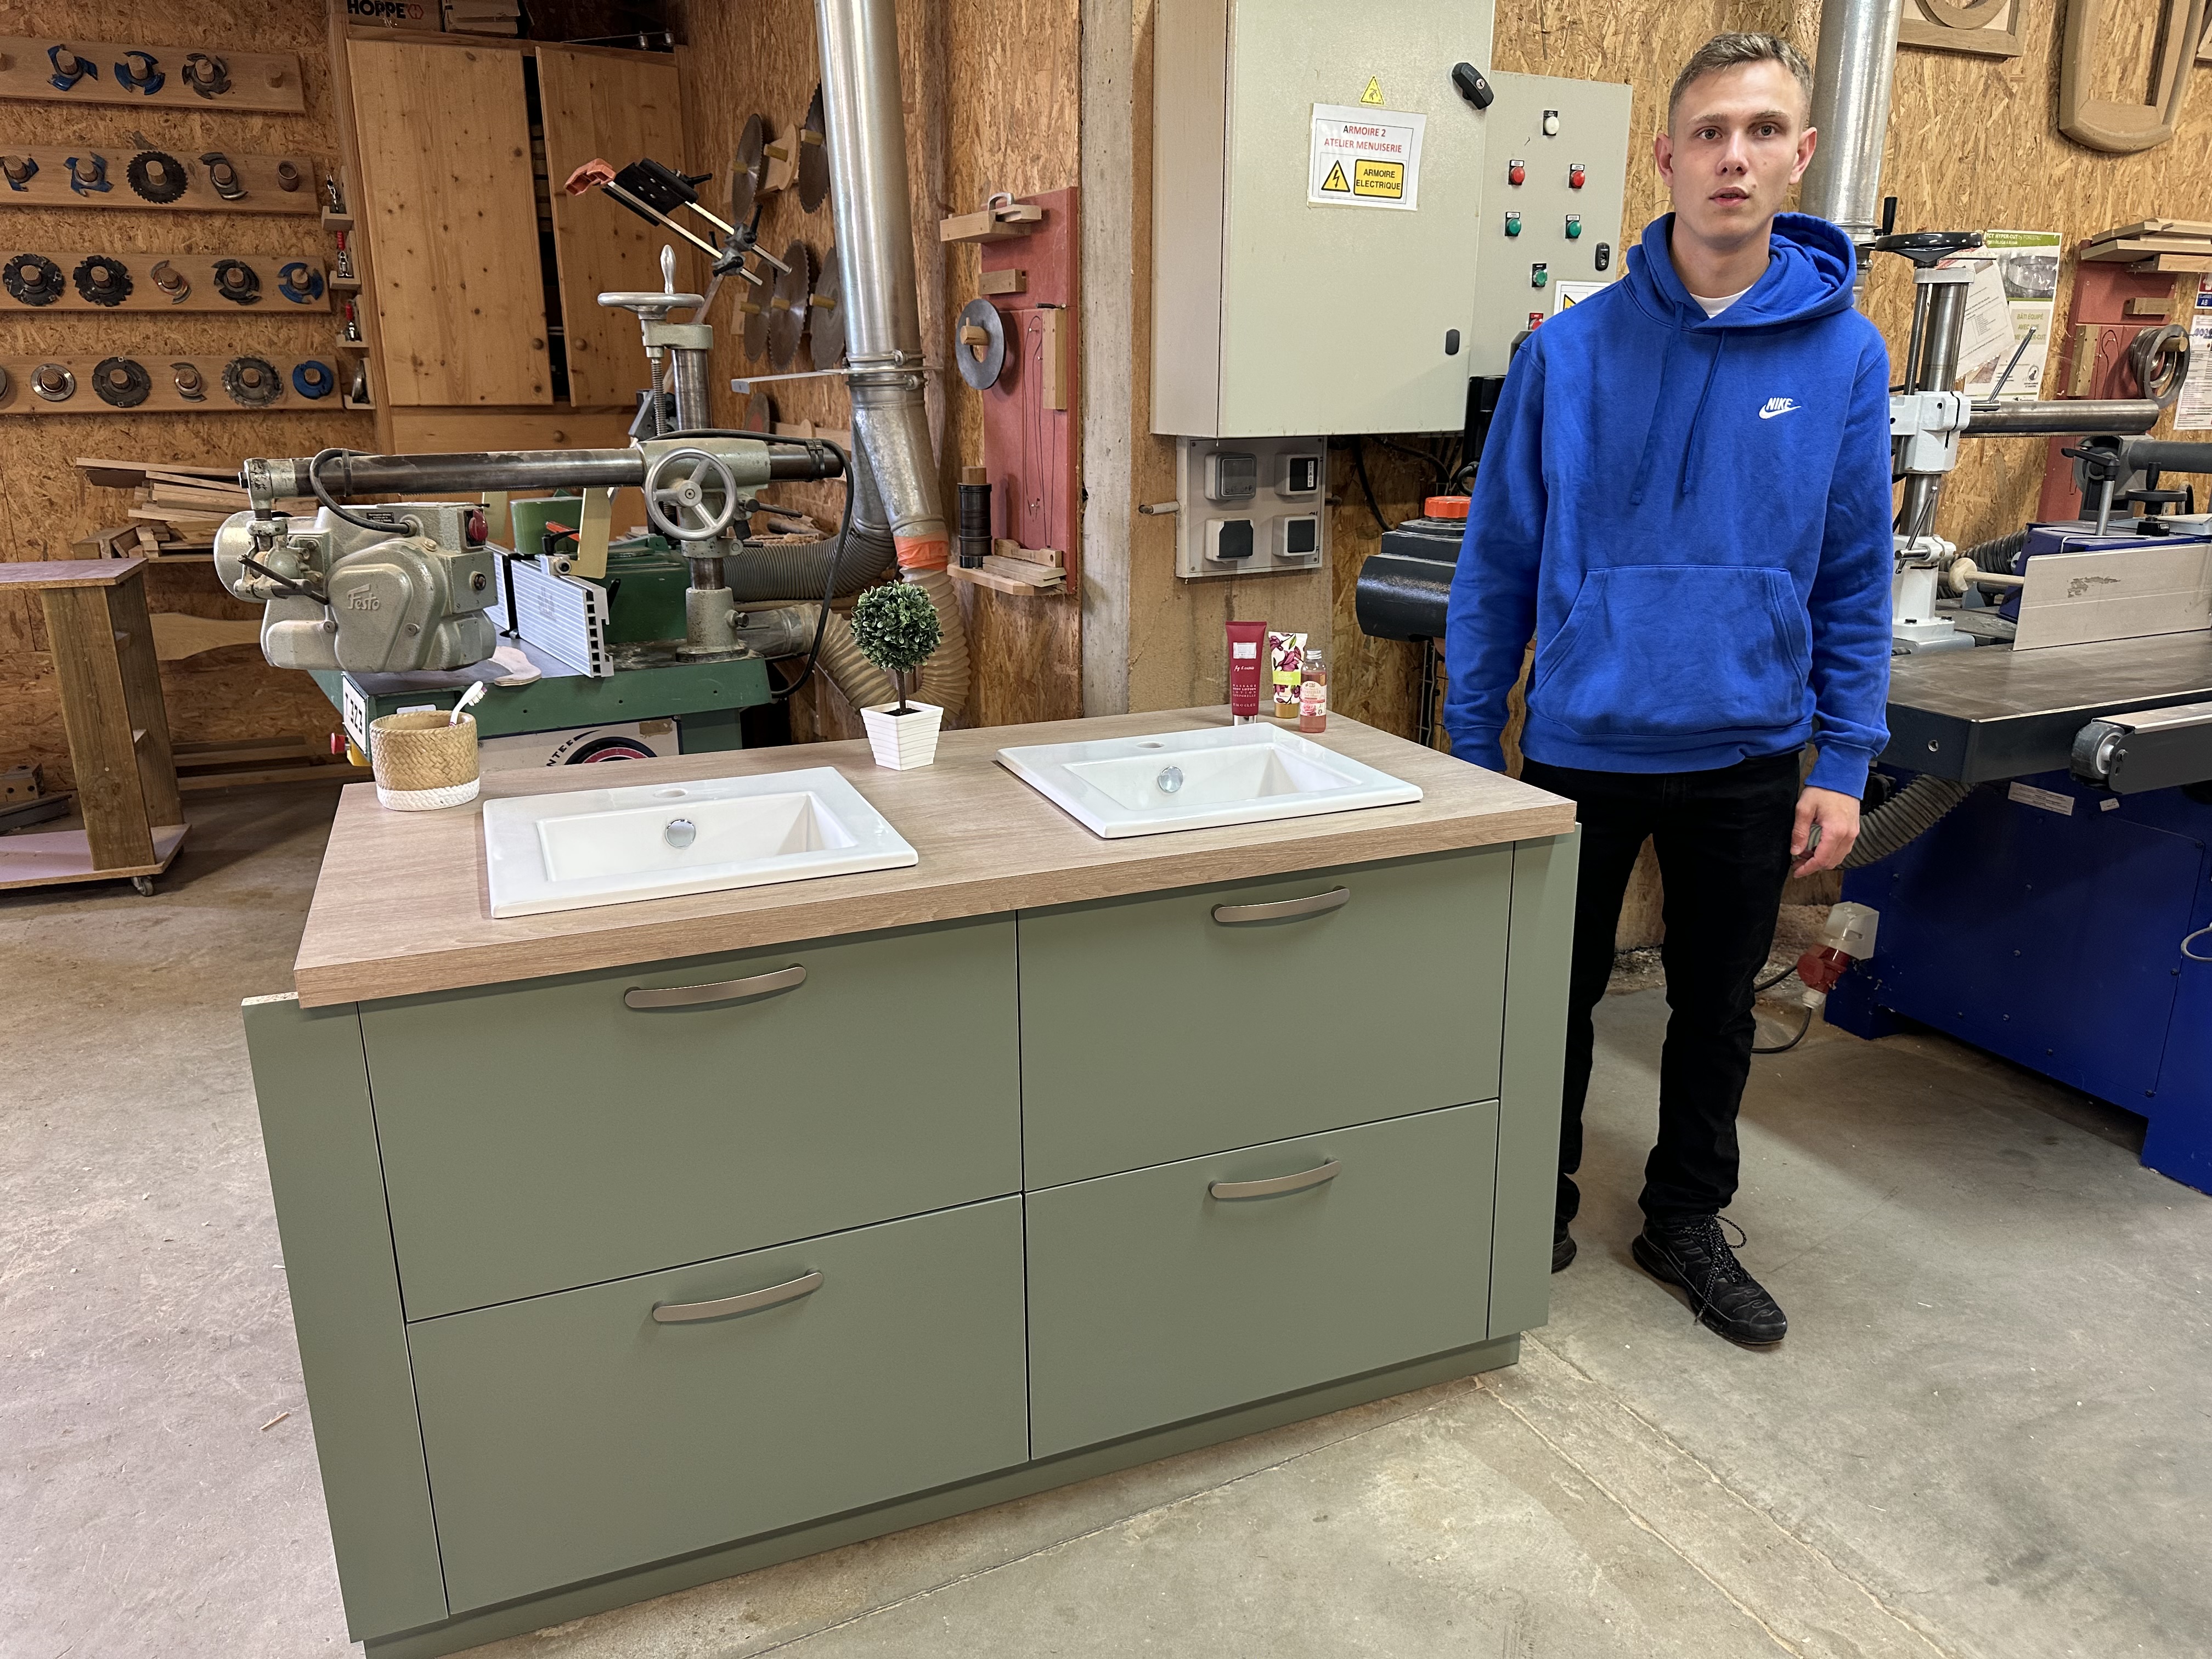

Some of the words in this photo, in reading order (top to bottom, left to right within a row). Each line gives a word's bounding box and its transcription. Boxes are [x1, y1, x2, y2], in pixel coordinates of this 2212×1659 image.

[347, 0, 406, 19] HOPPE
[1343, 125, 1379, 136] ARMOIRE
[1381, 129, 1386, 137] 2
[1324, 138, 1354, 149] ATELIER
[1356, 141, 1402, 153] MENUISERIE
[1363, 168, 1396, 178] ARMOIRE
[1356, 179, 1401, 190] ELECTRIQUE
[1766, 397, 1793, 410] NIKE
[346, 583, 380, 611] Festo
